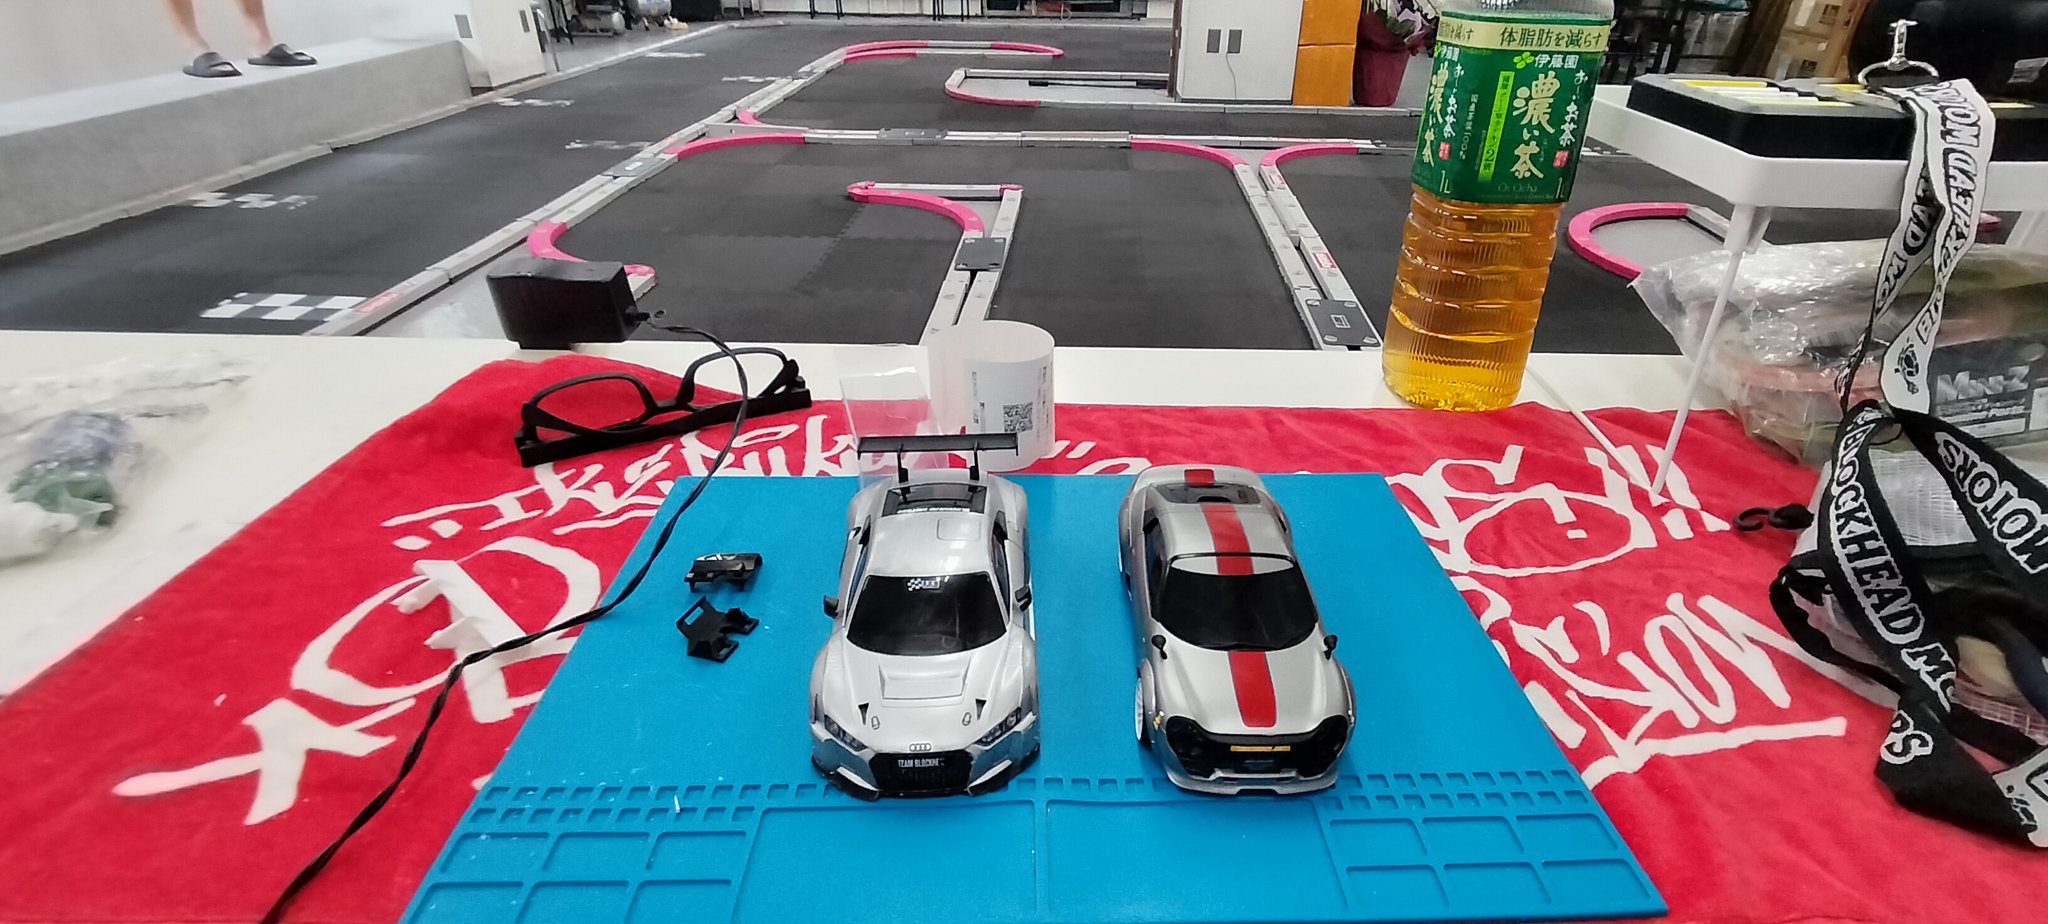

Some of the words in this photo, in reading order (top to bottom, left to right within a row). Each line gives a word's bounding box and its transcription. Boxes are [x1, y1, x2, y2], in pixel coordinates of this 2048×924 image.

[1500, 26, 1602, 48] 体脂肪を減らす
[1535, 53, 1579, 69] 伊藤園
[1510, 70, 1561, 179] 濃い茶
[1830, 423, 1925, 645] BLOCKHEAD
[897, 759, 913, 768] TEAM
[914, 757, 945, 768] BLOCKHE
